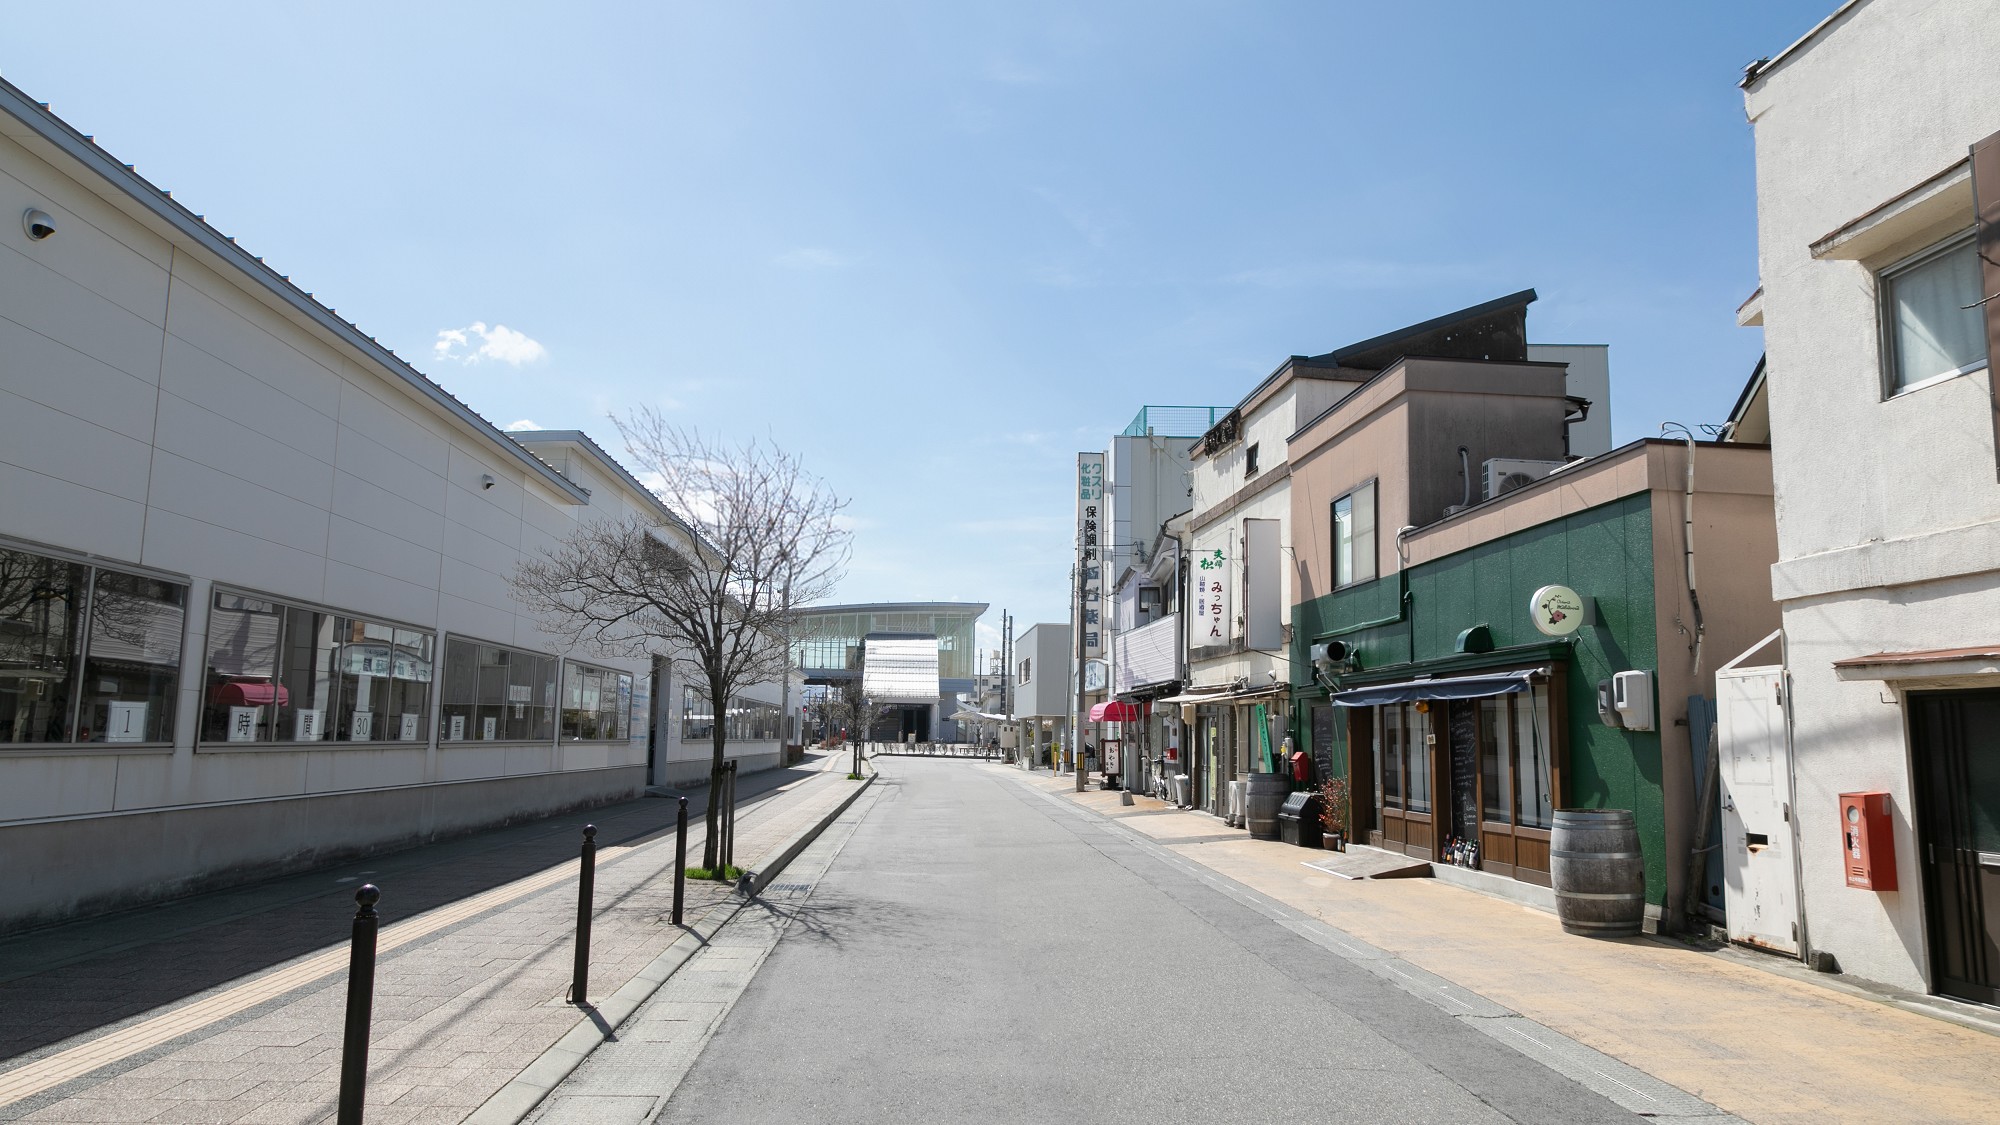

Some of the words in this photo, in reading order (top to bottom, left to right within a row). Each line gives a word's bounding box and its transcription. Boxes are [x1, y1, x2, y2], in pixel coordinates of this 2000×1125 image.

[1081, 463, 1091, 500] 化粧品
[1091, 463, 1102, 500] クスリ
[1085, 505, 1097, 561] 保険調剤
[1209, 581, 1223, 637] みっちゃん
[124, 709, 131, 733] 1
[237, 711, 251, 736] 時
[302, 713, 313, 737] 間
[356, 717, 368, 736] 30
[405, 718, 415, 736] 分
[1108, 746, 1116, 769] おやき
[1850, 825, 1861, 859] 消火器
